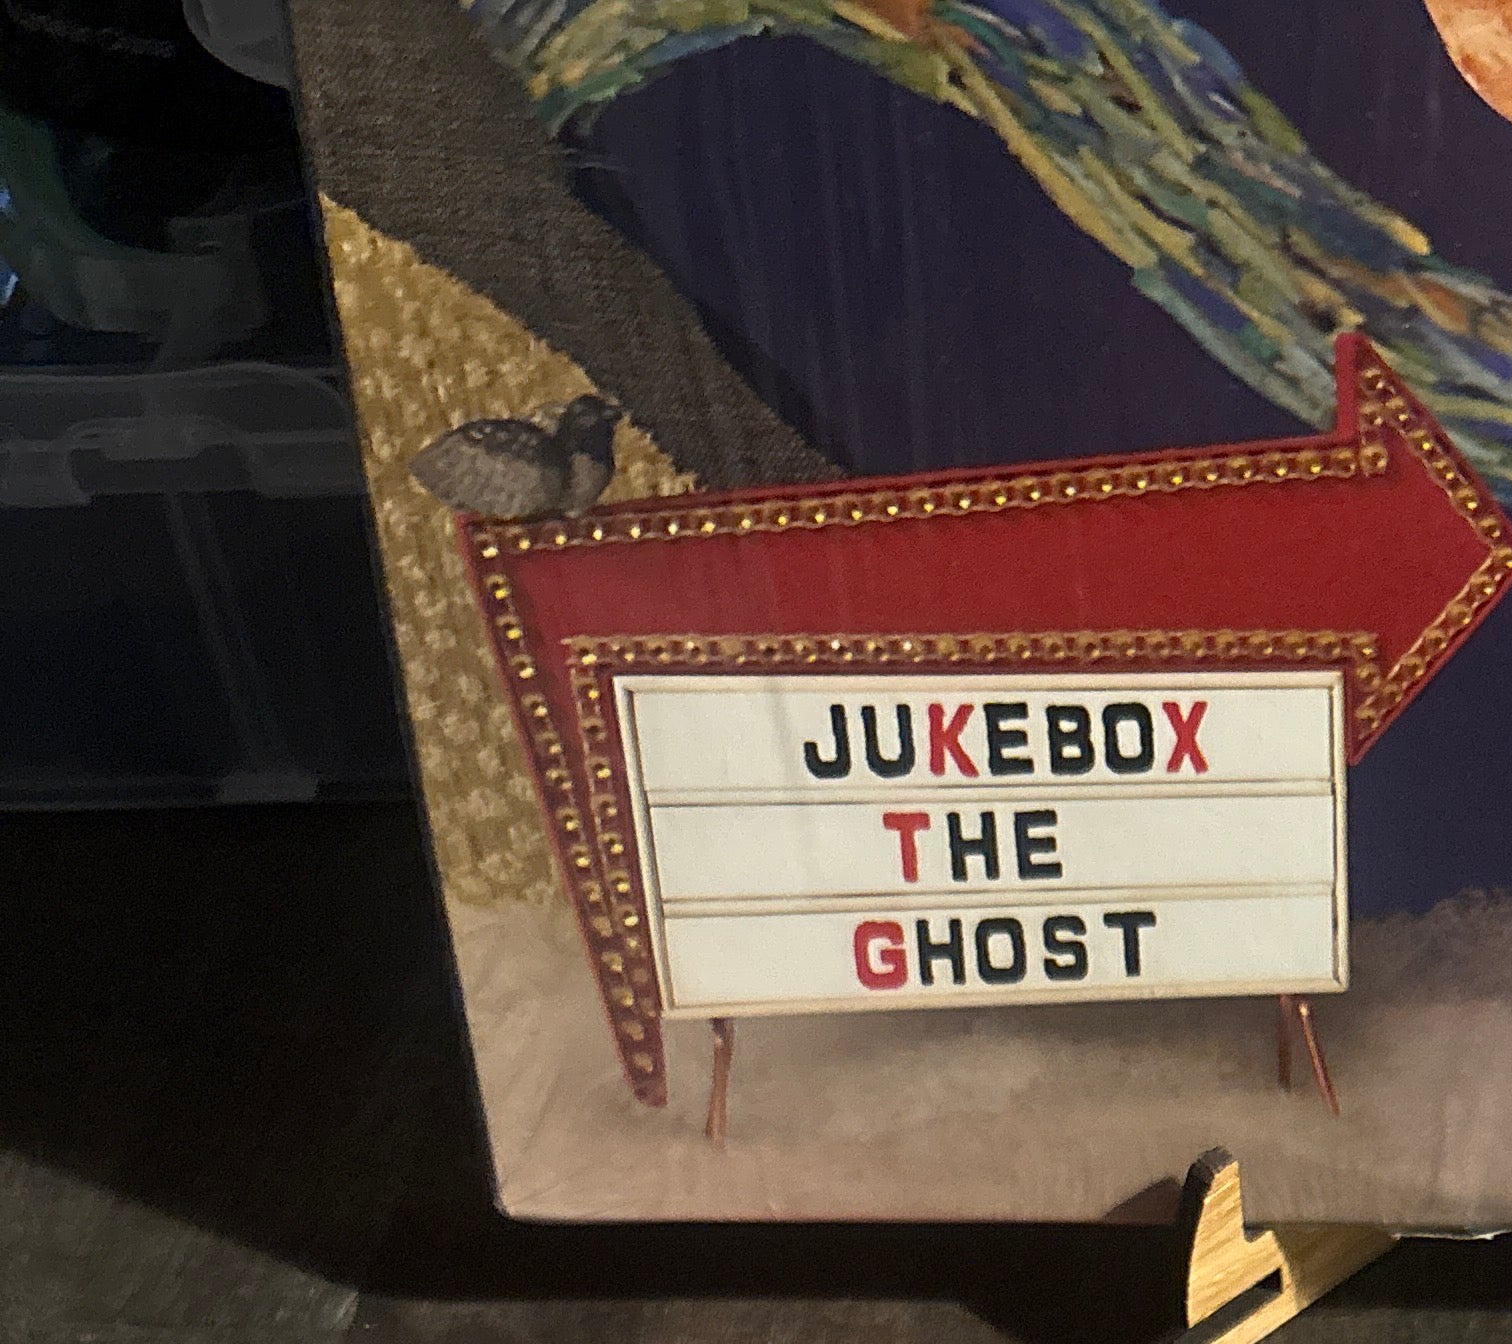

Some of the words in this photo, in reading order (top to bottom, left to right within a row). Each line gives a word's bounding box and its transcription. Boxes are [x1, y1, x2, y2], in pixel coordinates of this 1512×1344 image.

[804, 700, 1210, 779] JUKEBOX
[883, 809, 1064, 883] THE
[853, 911, 1157, 991] GHOST
